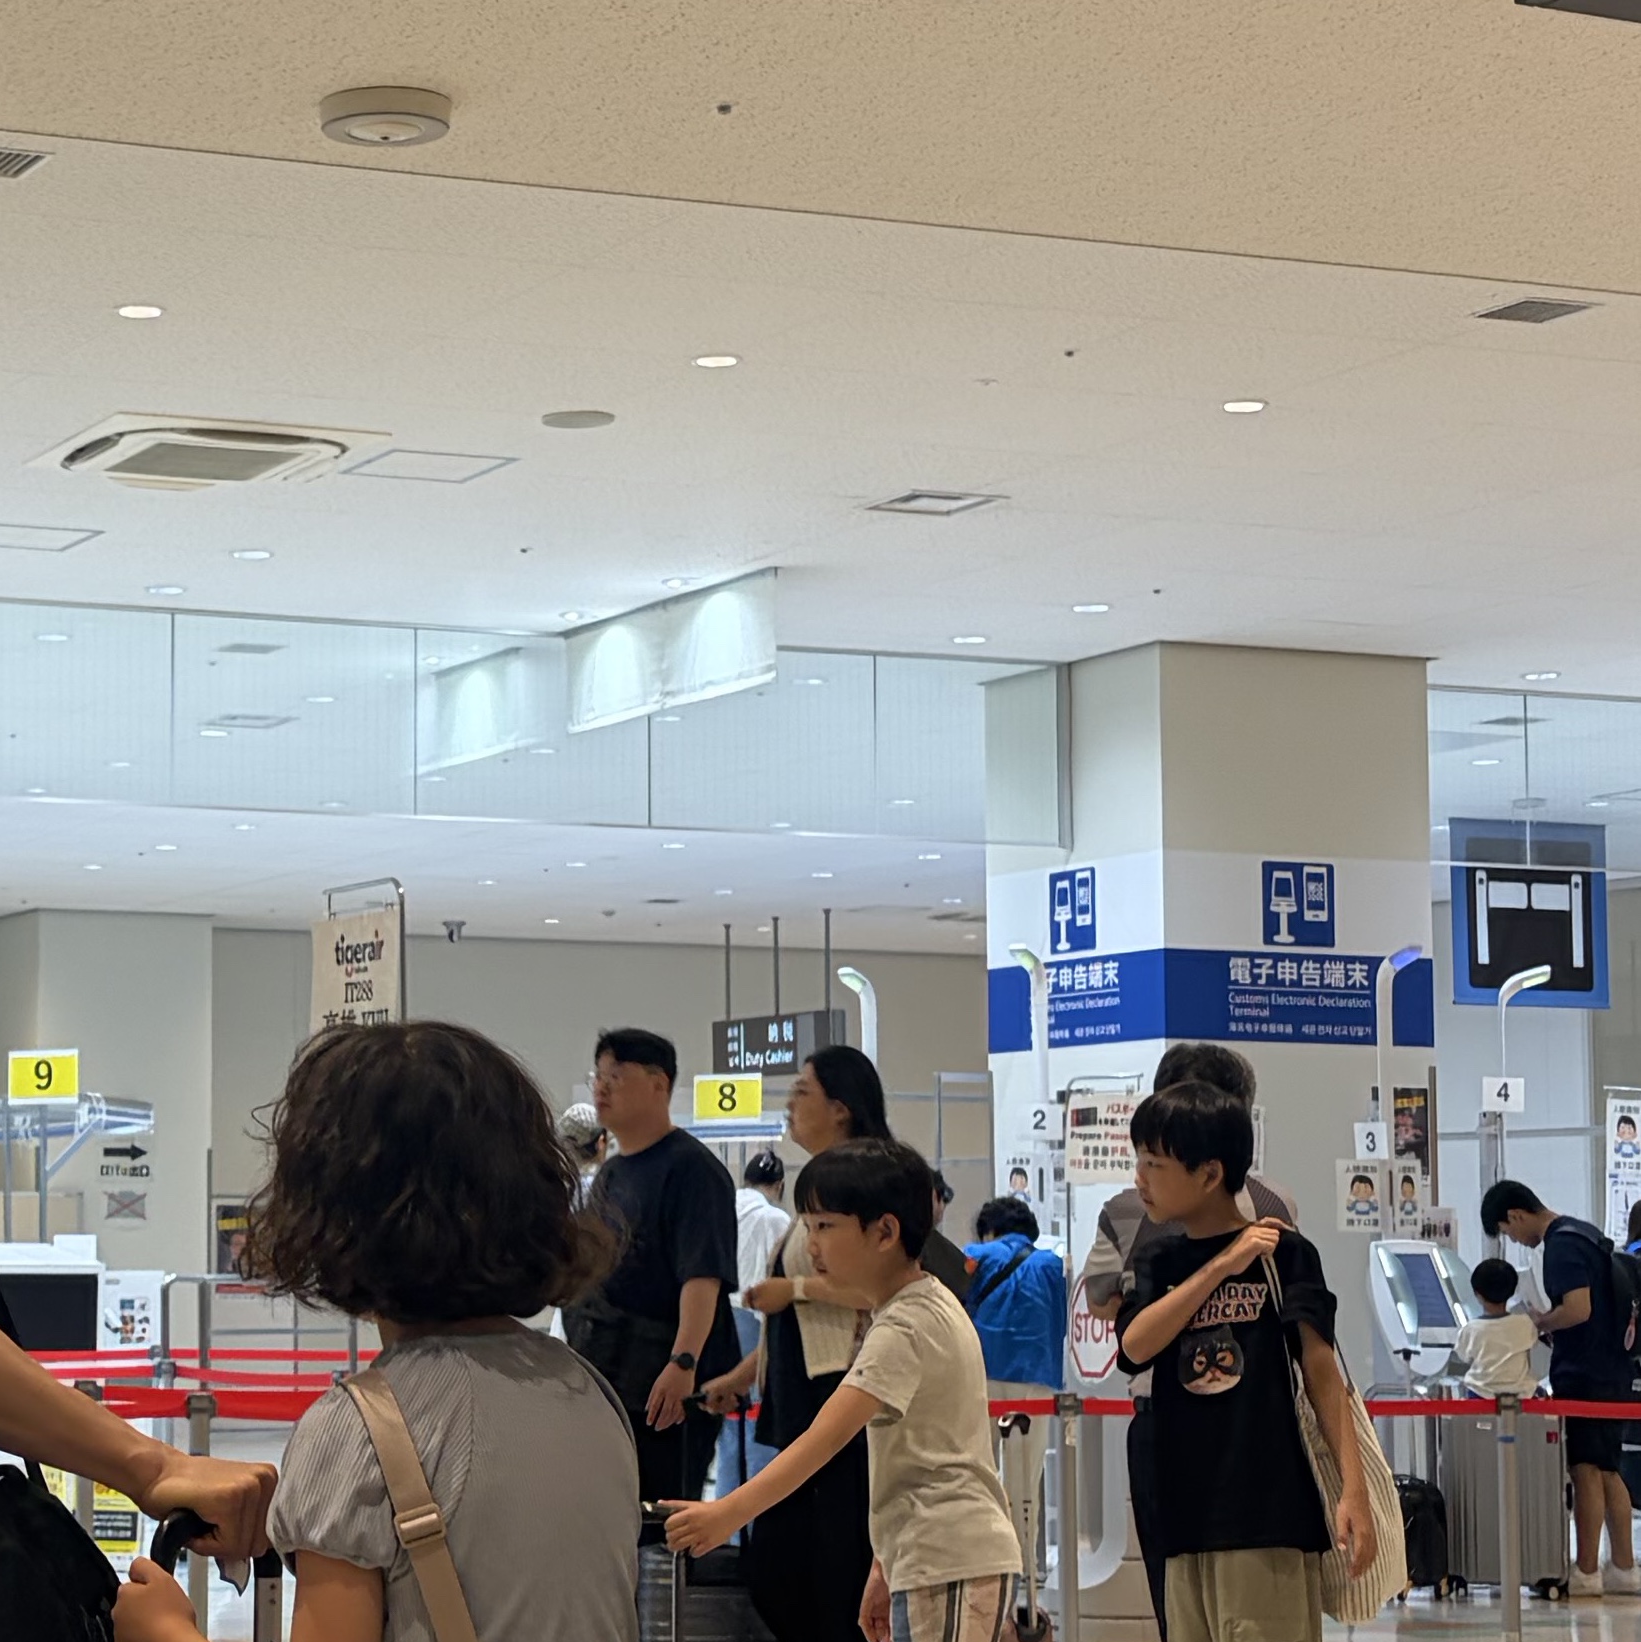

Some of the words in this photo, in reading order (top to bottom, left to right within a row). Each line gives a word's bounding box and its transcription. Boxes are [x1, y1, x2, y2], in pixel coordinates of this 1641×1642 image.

[1045, 960, 1119, 994] 子申告端末
[1229, 957, 1369, 988] 電子申告端末
[1271, 993, 1317, 1007] Electronic
[1318, 995, 1371, 1008] Declaration
[1229, 1006, 1270, 1018] Terminal
[765, 1047, 794, 1065] Cashier
[34, 1059, 53, 1091] 9
[718, 1082, 737, 1112] 8
[1496, 1082, 1510, 1102] 4
[1033, 1109, 1046, 1130] 2
[1365, 1131, 1376, 1152] 3
